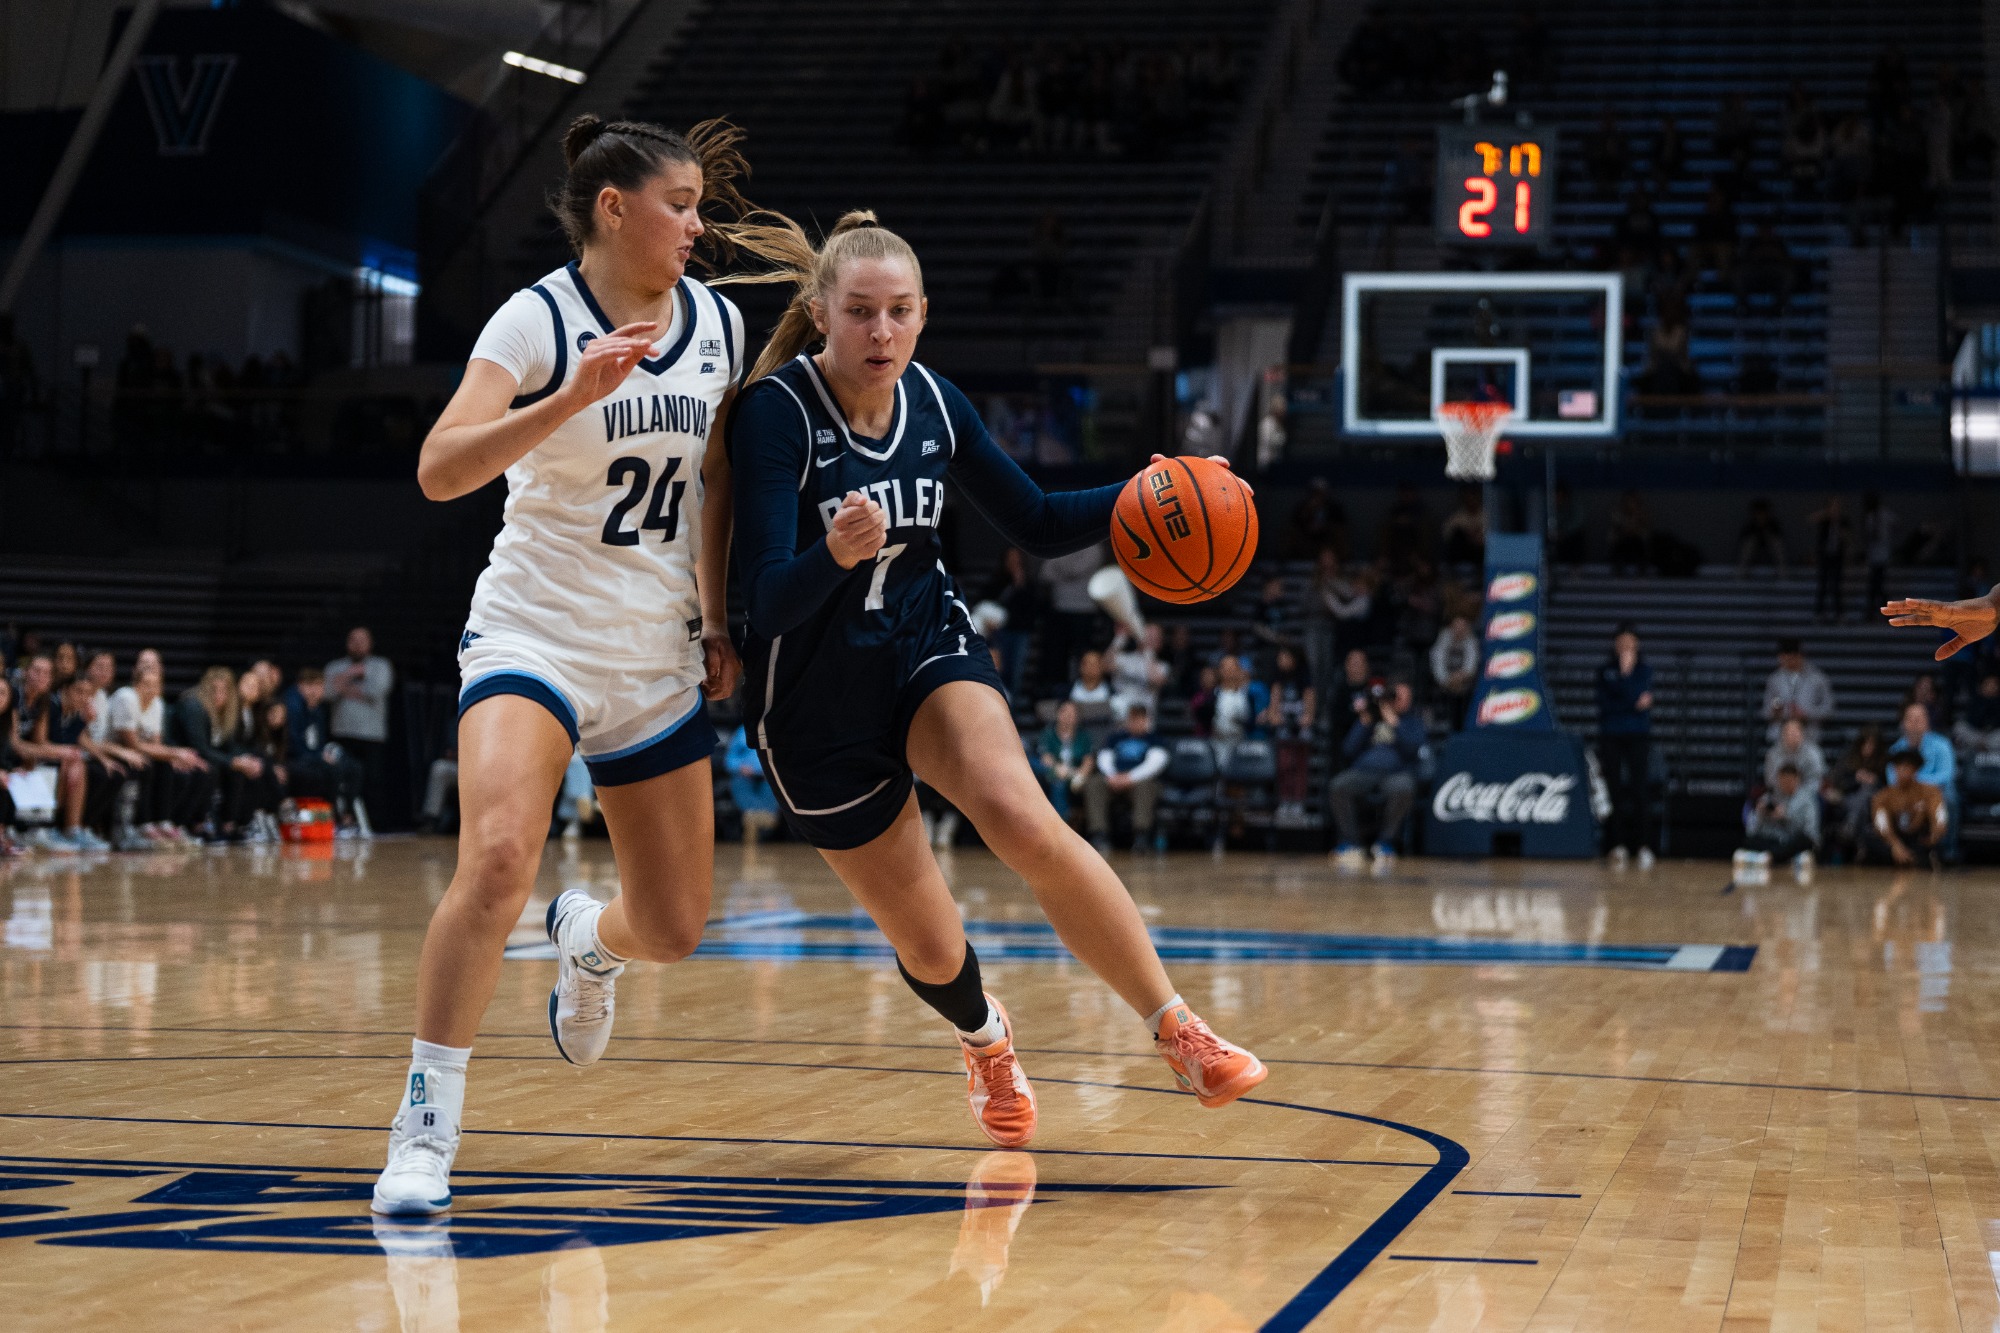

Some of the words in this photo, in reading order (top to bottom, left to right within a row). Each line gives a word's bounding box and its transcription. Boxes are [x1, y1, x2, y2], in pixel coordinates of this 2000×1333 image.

[133, 53, 239, 156] V
[1458, 176, 1531, 238] 21
[603, 394, 707, 442] VILLANOVA
[817, 435, 837, 444] HANGE
[922, 445, 940, 453] EAST
[601, 456, 687, 546] 24
[817, 477, 944, 533] BTLER
[1149, 469, 1192, 543] ELITE
[865, 543, 909, 611] 7
